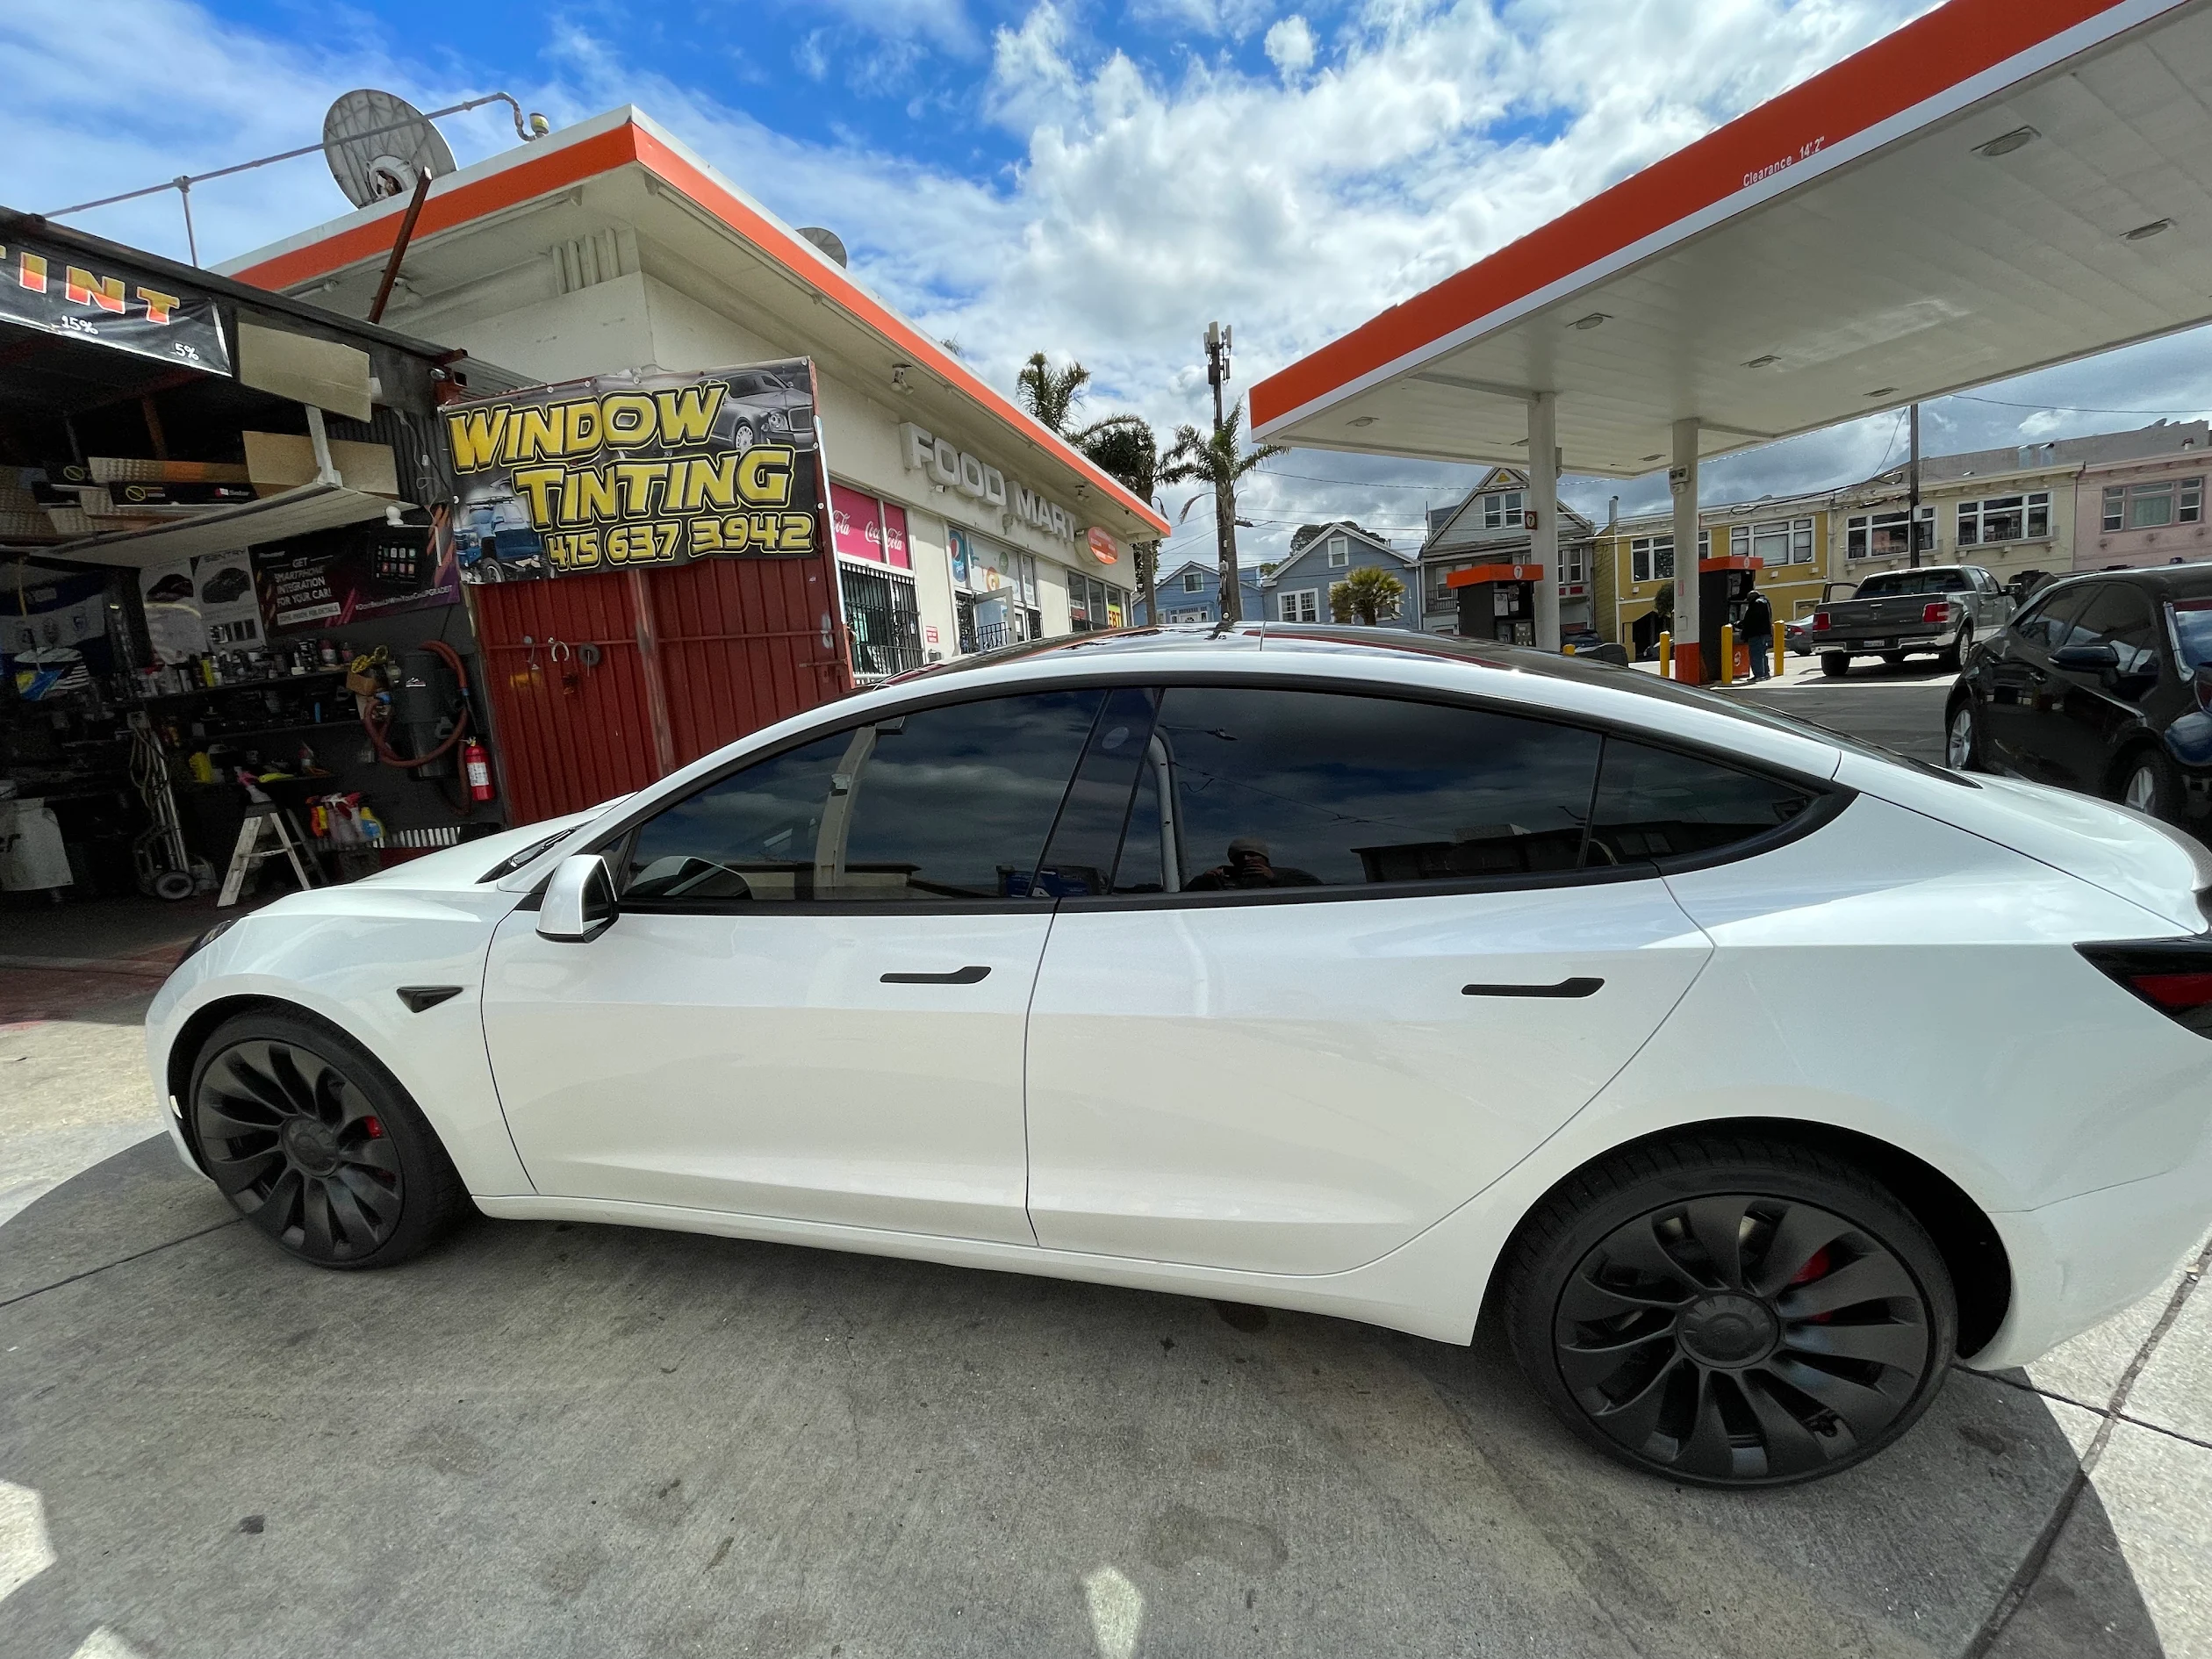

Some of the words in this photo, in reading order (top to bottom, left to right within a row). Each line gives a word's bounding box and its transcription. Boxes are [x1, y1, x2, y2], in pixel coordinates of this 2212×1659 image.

[1743, 155, 1792, 187] Clearance
[61, 314, 99, 335] 15%
[175, 342, 200, 361] 5%
[446, 384, 729, 473] WINDOW
[513, 446, 794, 532] TINTING
[901, 422, 1007, 506] FOOD
[1007, 481, 1077, 542] MART
[546, 529, 600, 571] 415
[606, 520, 681, 564] 637
[689, 513, 813, 557] 3942
[274, 564, 326, 583] SMARTPHONE
[292, 557, 308, 569] GET
[276, 576, 326, 594] INTEGRATION
[276, 596, 291, 607] FOR
[291, 592, 312, 604] YOUR
[312, 587, 333, 600] CAR!
